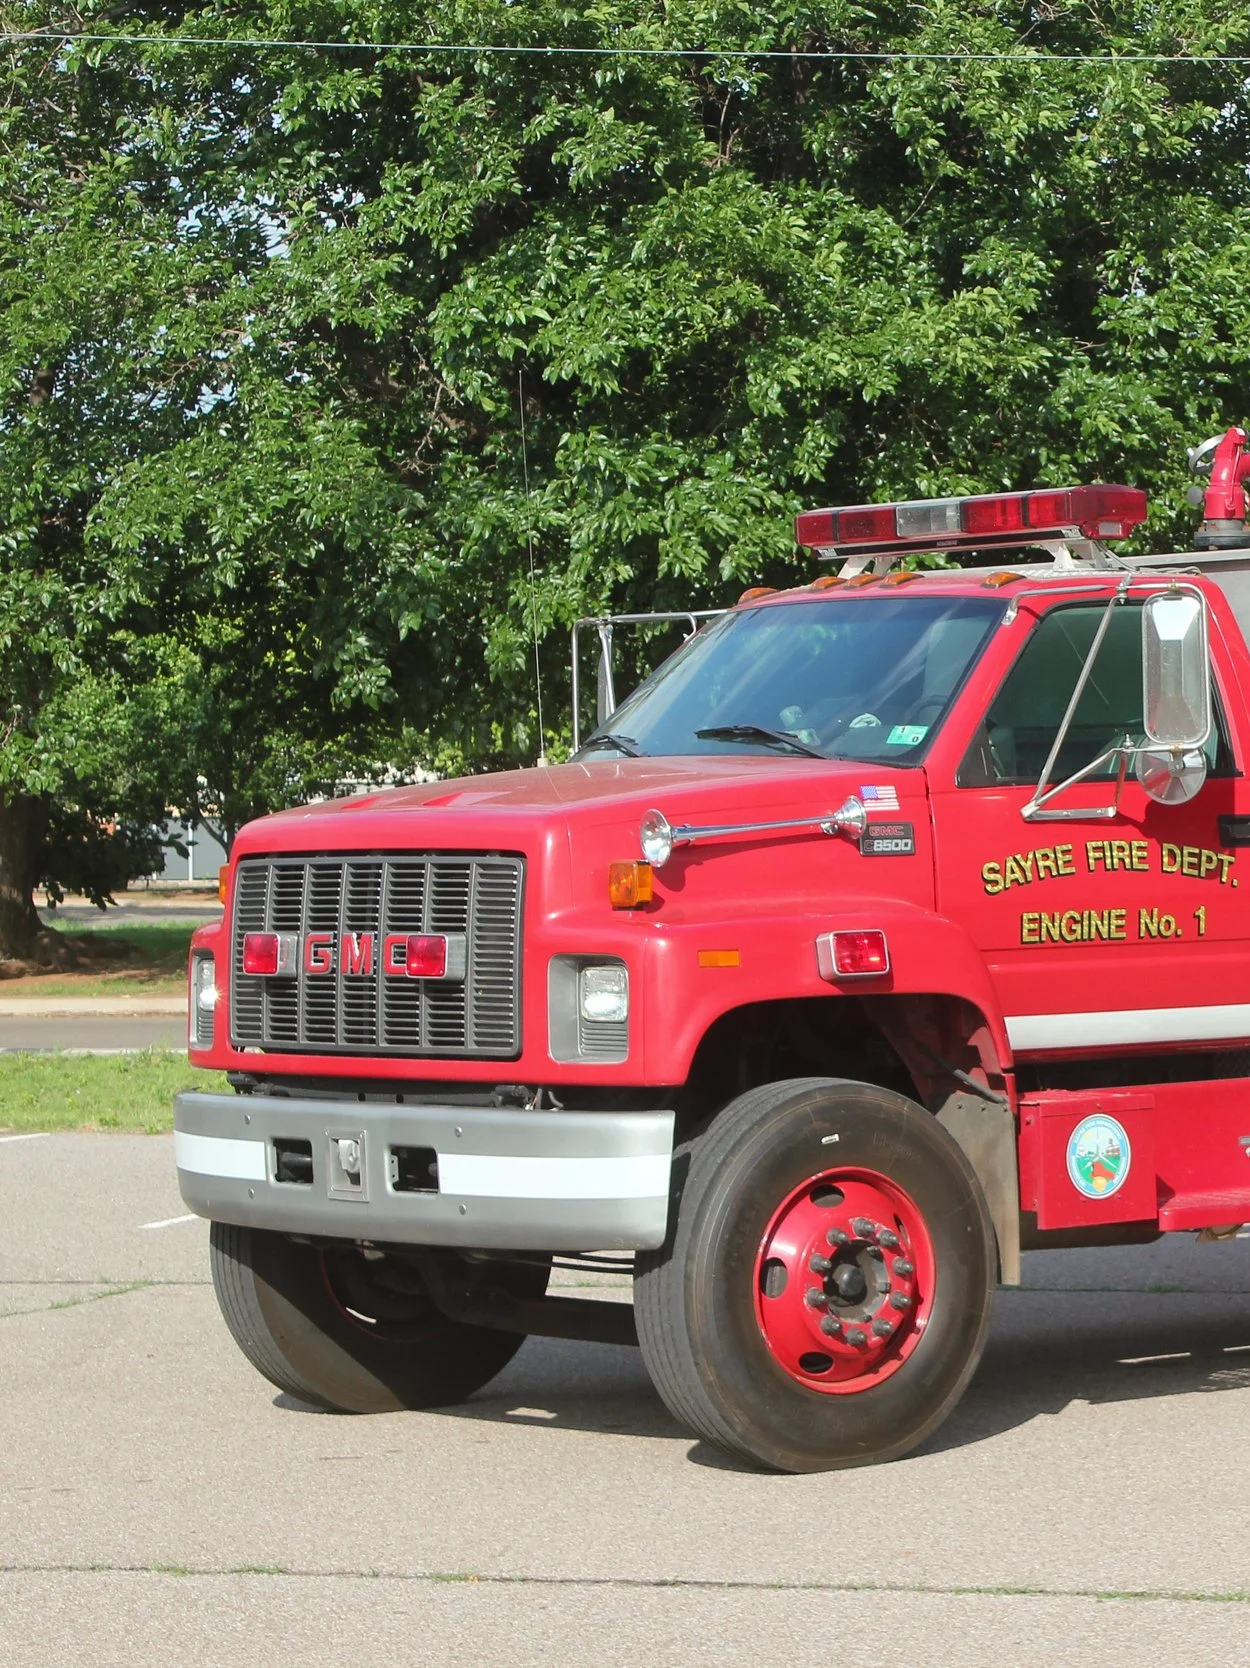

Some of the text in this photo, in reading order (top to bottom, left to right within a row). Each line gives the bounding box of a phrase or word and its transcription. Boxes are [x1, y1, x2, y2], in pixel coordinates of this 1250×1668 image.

[864, 839, 911, 851] C8500
[869, 826, 904, 836] GMC
[982, 840, 1239, 895] SAYRE FIRE DEPT.
[1020, 906, 1207, 944] ENGINE No. 1
[303, 933, 407, 974] GMC
